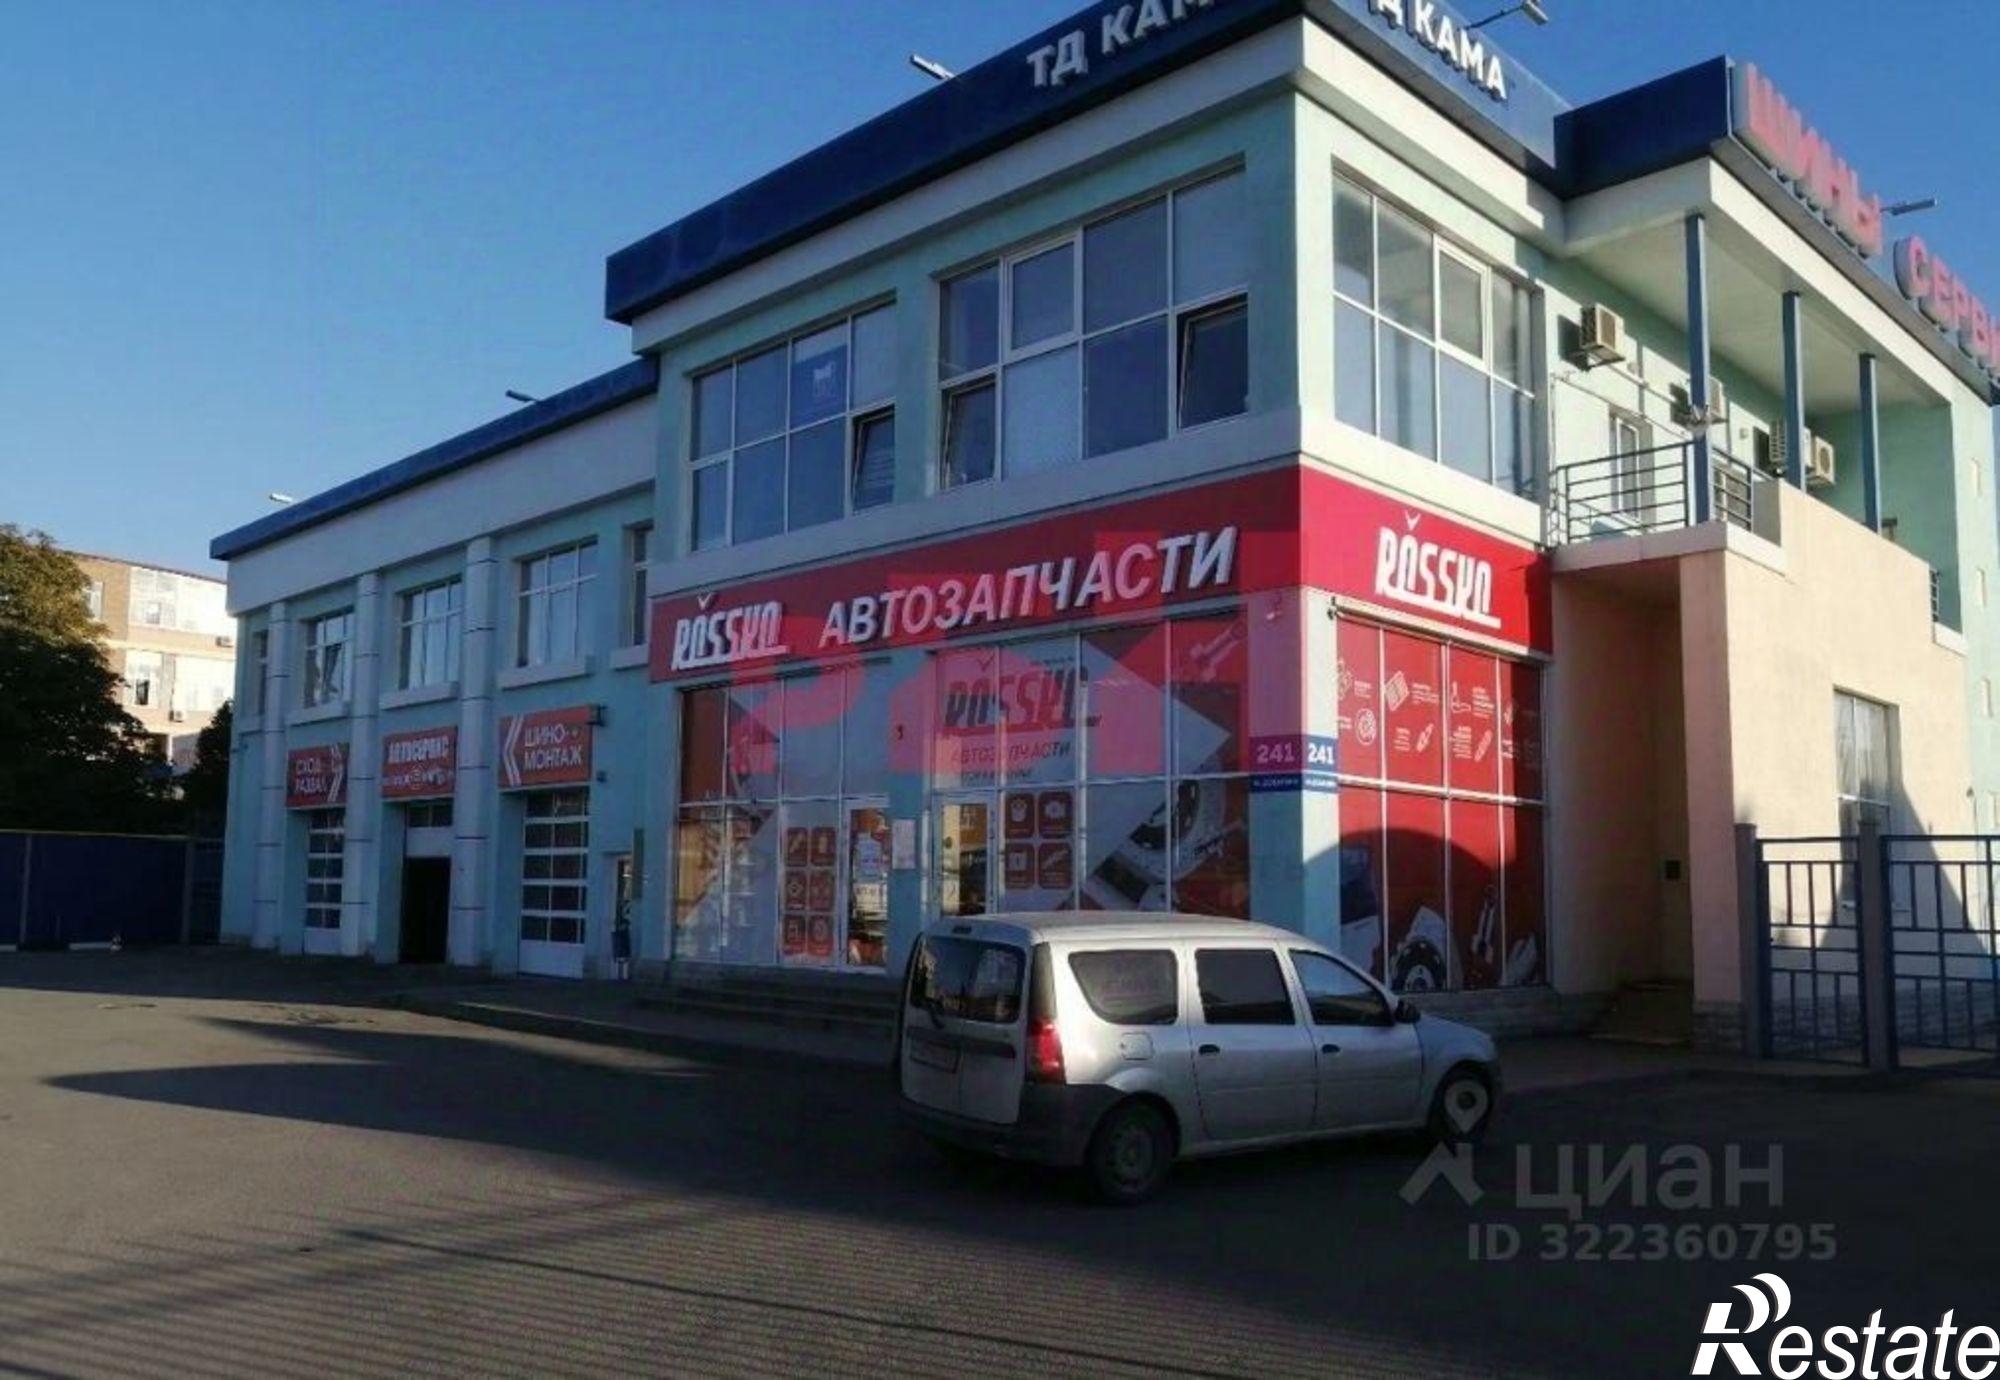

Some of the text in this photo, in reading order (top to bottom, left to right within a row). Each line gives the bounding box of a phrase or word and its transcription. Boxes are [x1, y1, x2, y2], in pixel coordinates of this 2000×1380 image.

[1026, 30, 1089, 87] ТД
[1408, 0, 1507, 101] КАМА
[1735, 62, 1882, 258] ШИНЫ
[818, 526, 1239, 649] АВТОЗАПЧАСТИ
[524, 745, 582, 771] МОНТАЖ
[1257, 743, 1295, 763] 241
[1307, 742, 1335, 764] 241
